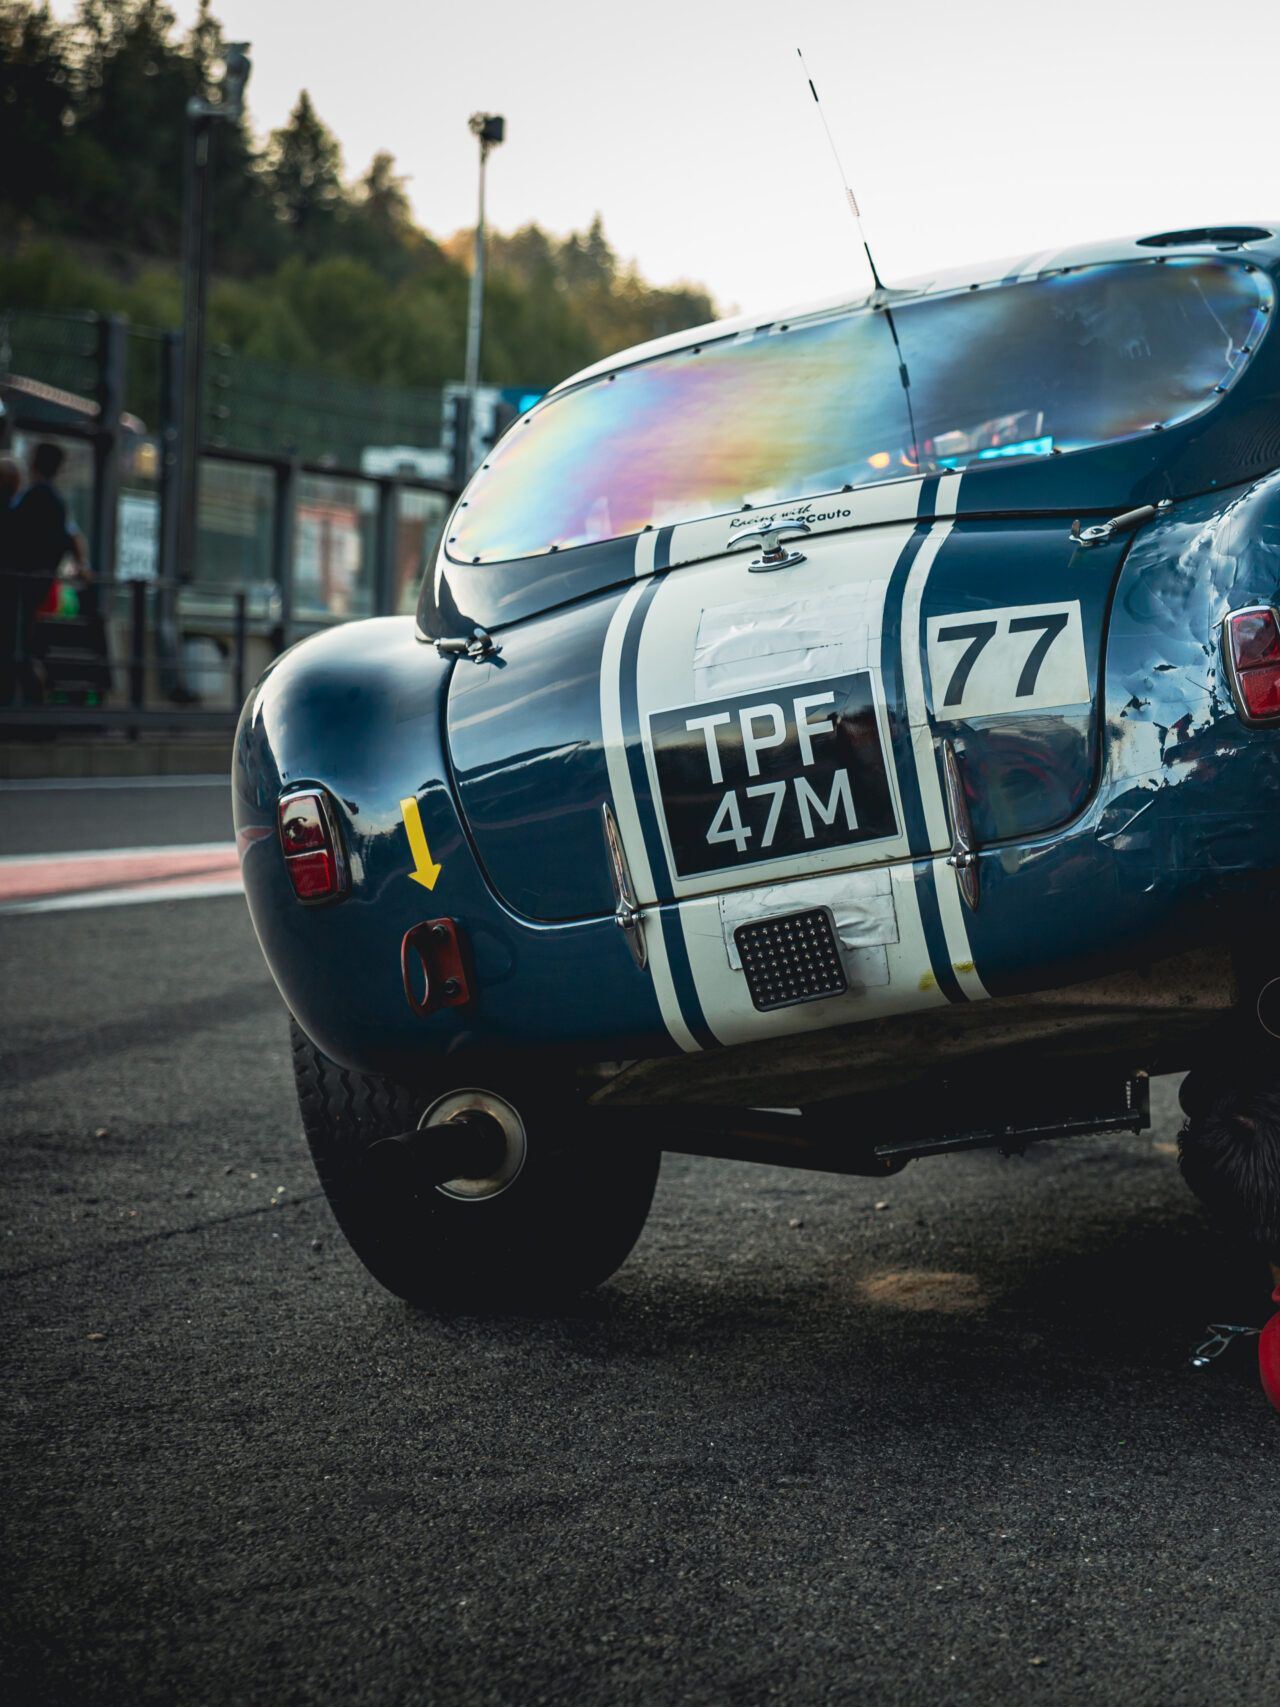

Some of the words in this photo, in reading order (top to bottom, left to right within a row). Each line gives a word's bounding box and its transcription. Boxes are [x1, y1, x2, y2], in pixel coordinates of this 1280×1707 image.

[729, 513, 776, 529] Racing
[782, 504, 812, 518] with
[936, 612, 1069, 707] 77
[685, 690, 836, 785] TPF
[705, 768, 859, 852] 47M
